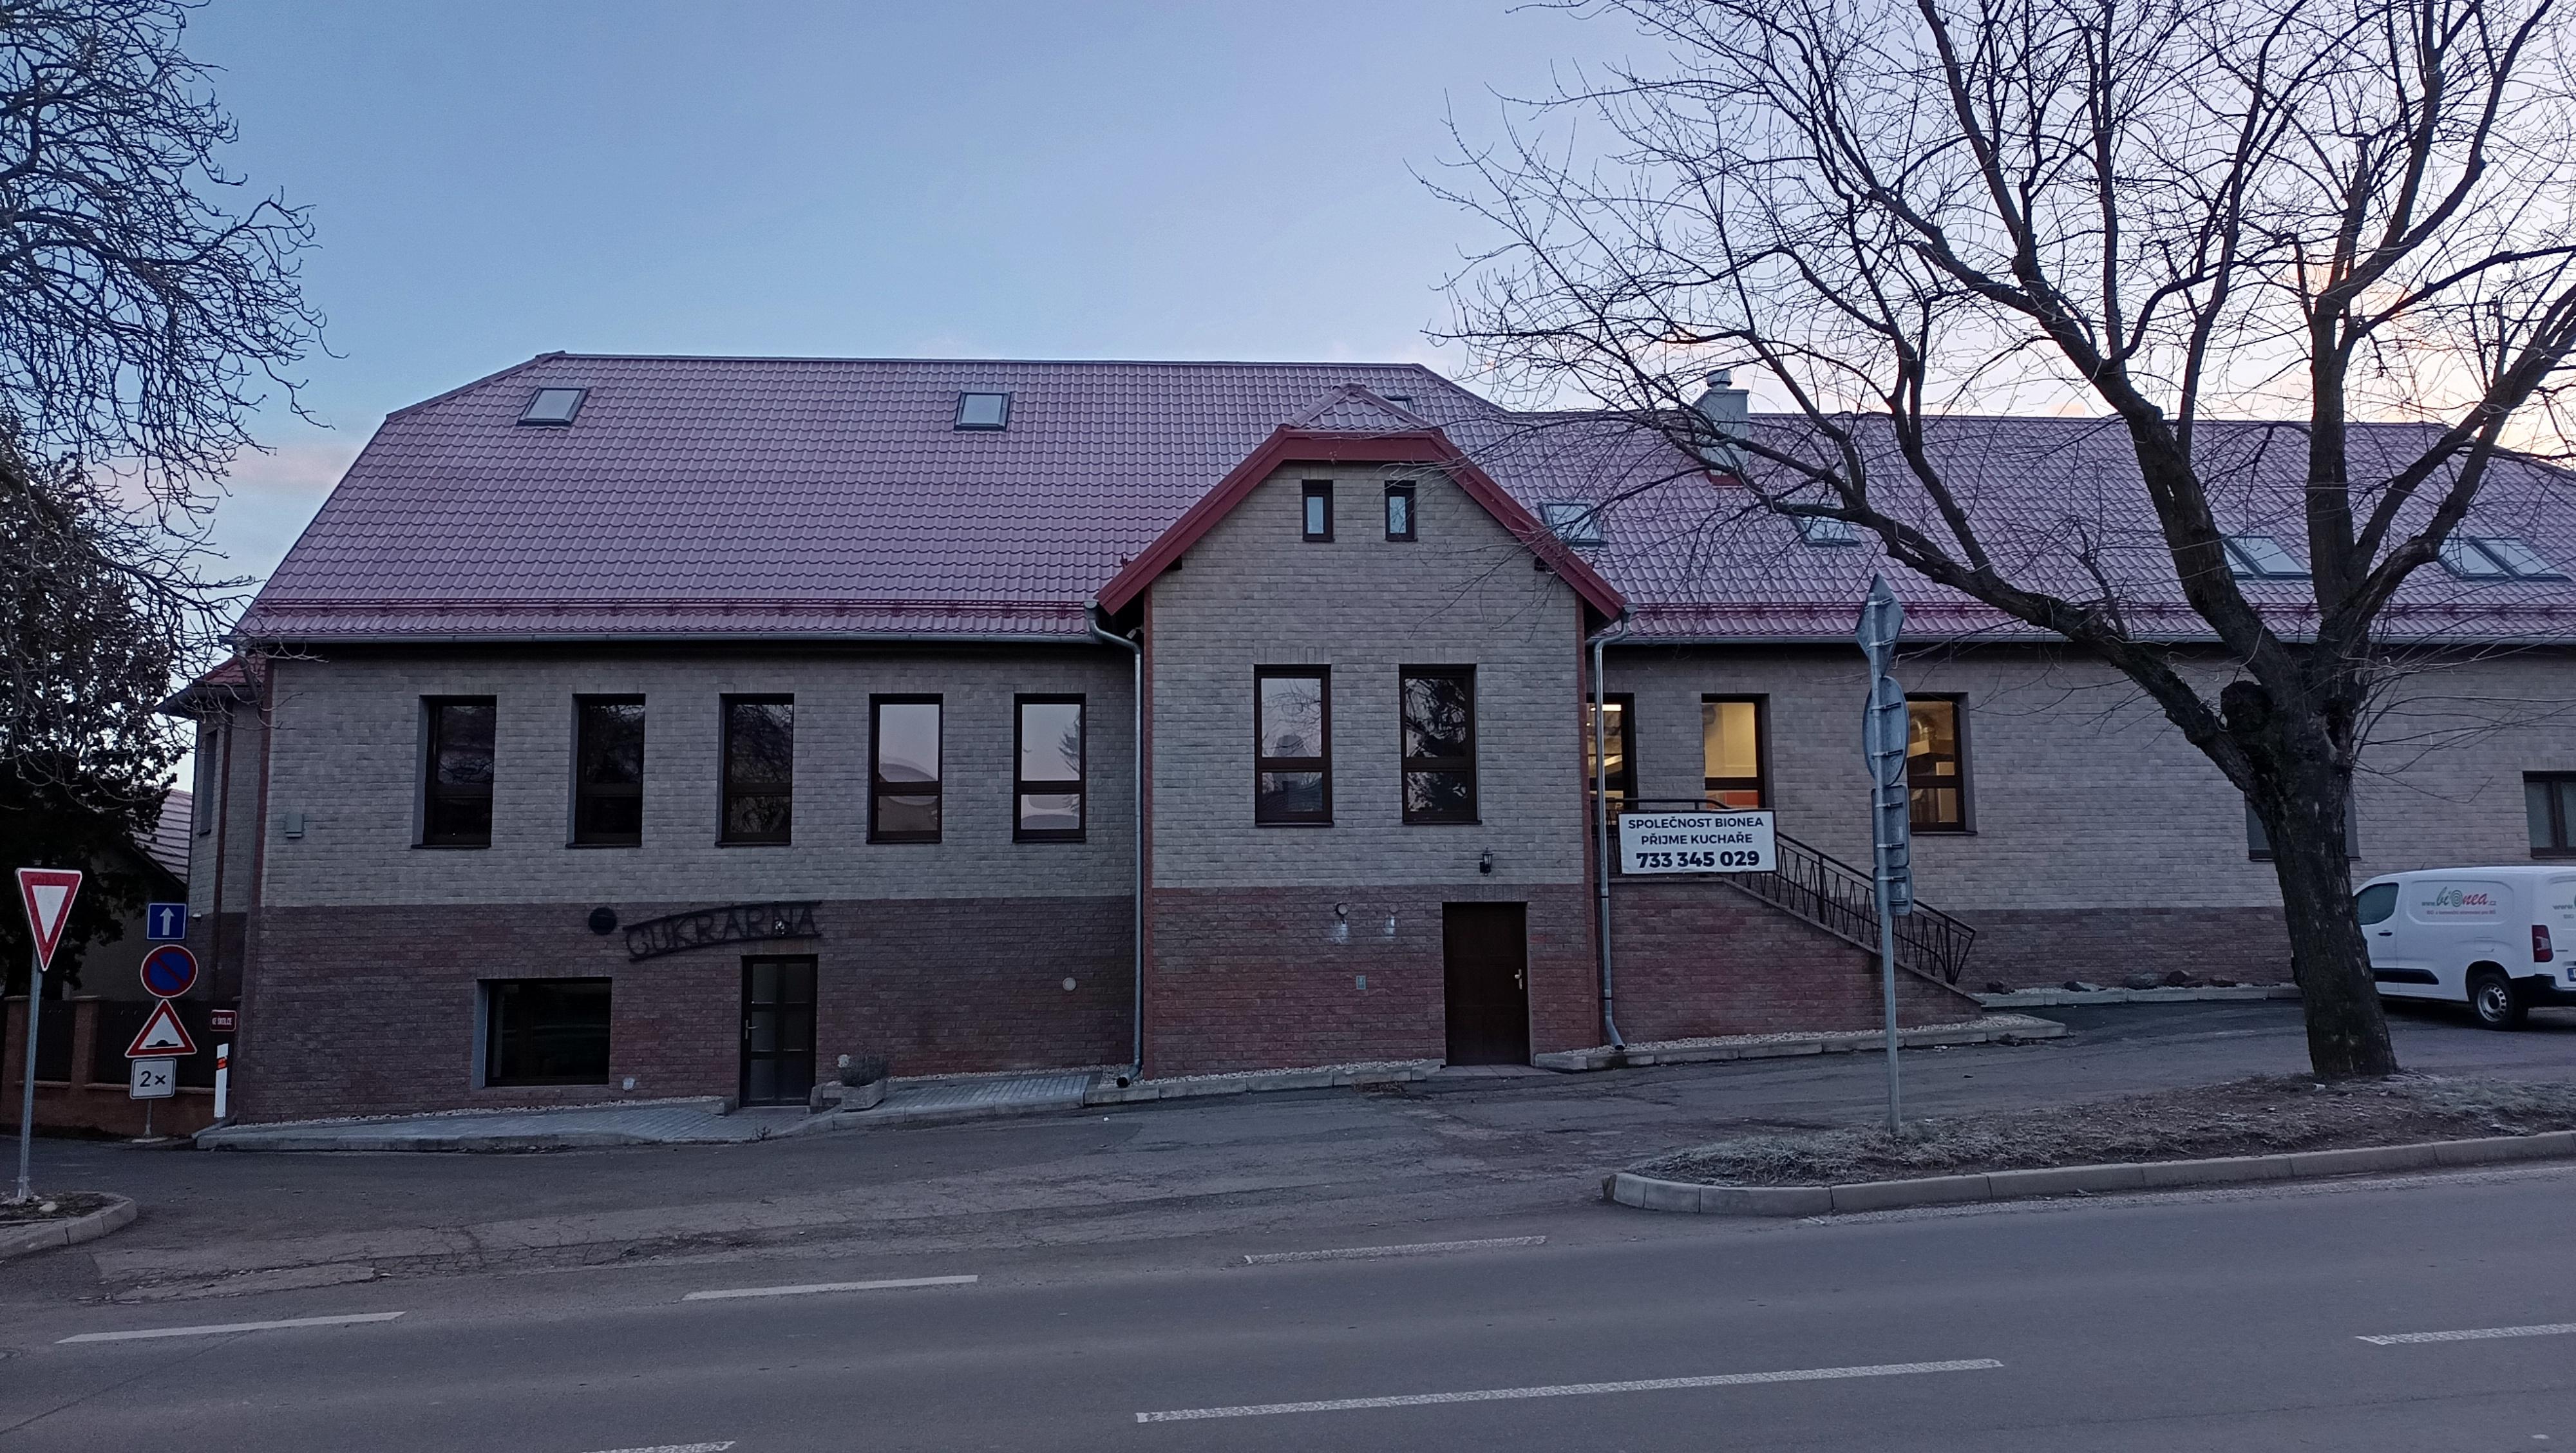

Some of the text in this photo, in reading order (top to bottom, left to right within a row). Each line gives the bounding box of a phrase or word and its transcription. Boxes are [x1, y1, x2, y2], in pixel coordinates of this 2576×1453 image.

[1628, 816, 1764, 829] SPOLEČNOST BIONEA
[1641, 831, 1753, 845] PŘIJME KUCHAŘE
[1636, 851, 1759, 868] 733 345 029
